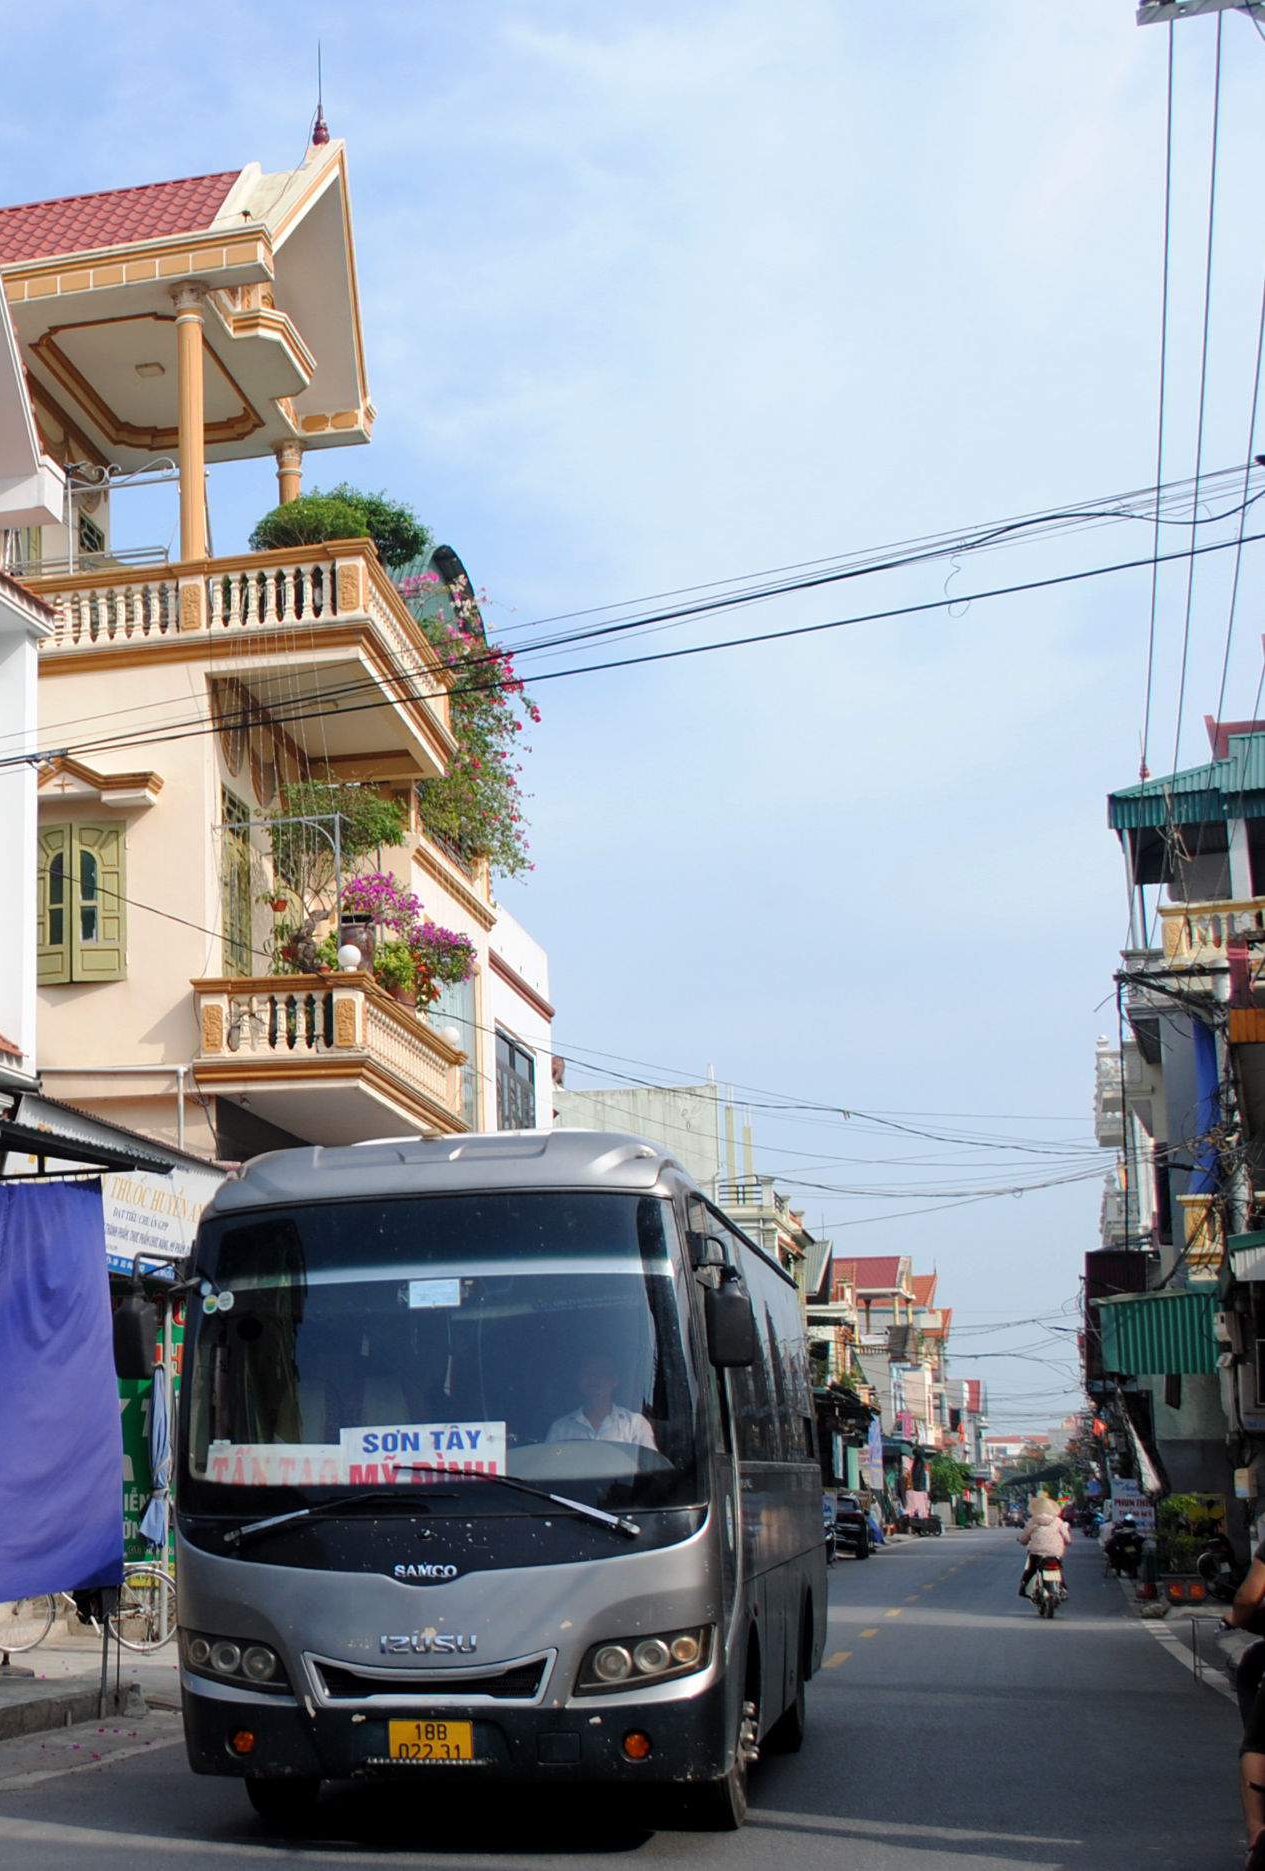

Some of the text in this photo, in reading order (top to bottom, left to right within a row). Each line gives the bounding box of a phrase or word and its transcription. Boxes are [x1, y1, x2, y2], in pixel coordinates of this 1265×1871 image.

[158, 1221, 169, 1231] GPP
[362, 1426, 482, 1454] SƠN TÂY
[349, 1454, 401, 1485] MỸ
[394, 1564, 457, 1578] SAMCO
[415, 1723, 447, 1741] 18B
